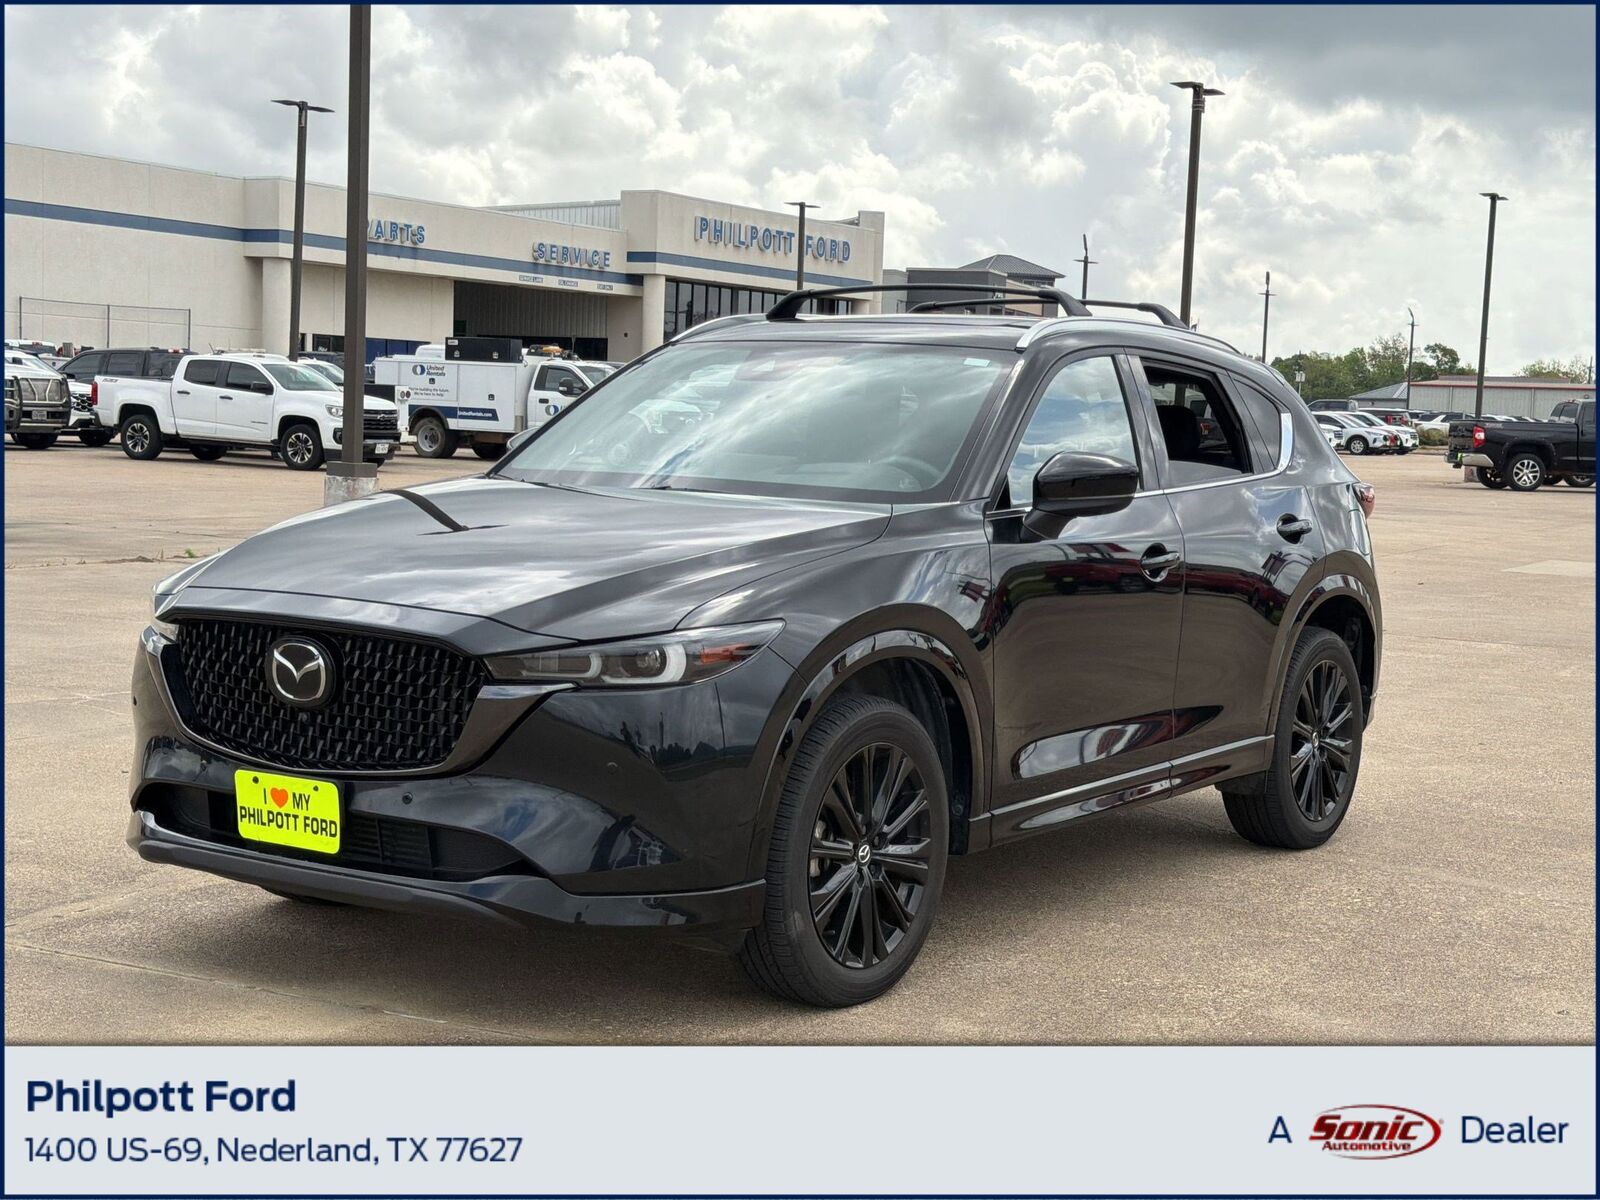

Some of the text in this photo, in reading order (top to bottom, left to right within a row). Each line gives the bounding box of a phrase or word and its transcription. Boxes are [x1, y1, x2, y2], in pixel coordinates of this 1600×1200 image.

[368, 218, 425, 245] ARTS
[697, 216, 850, 262] PHILPOTT FORD
[535, 242, 611, 268] SERVICE
[263, 787, 311, 811] I MY
[239, 805, 338, 838] PHILPOTT FORD
